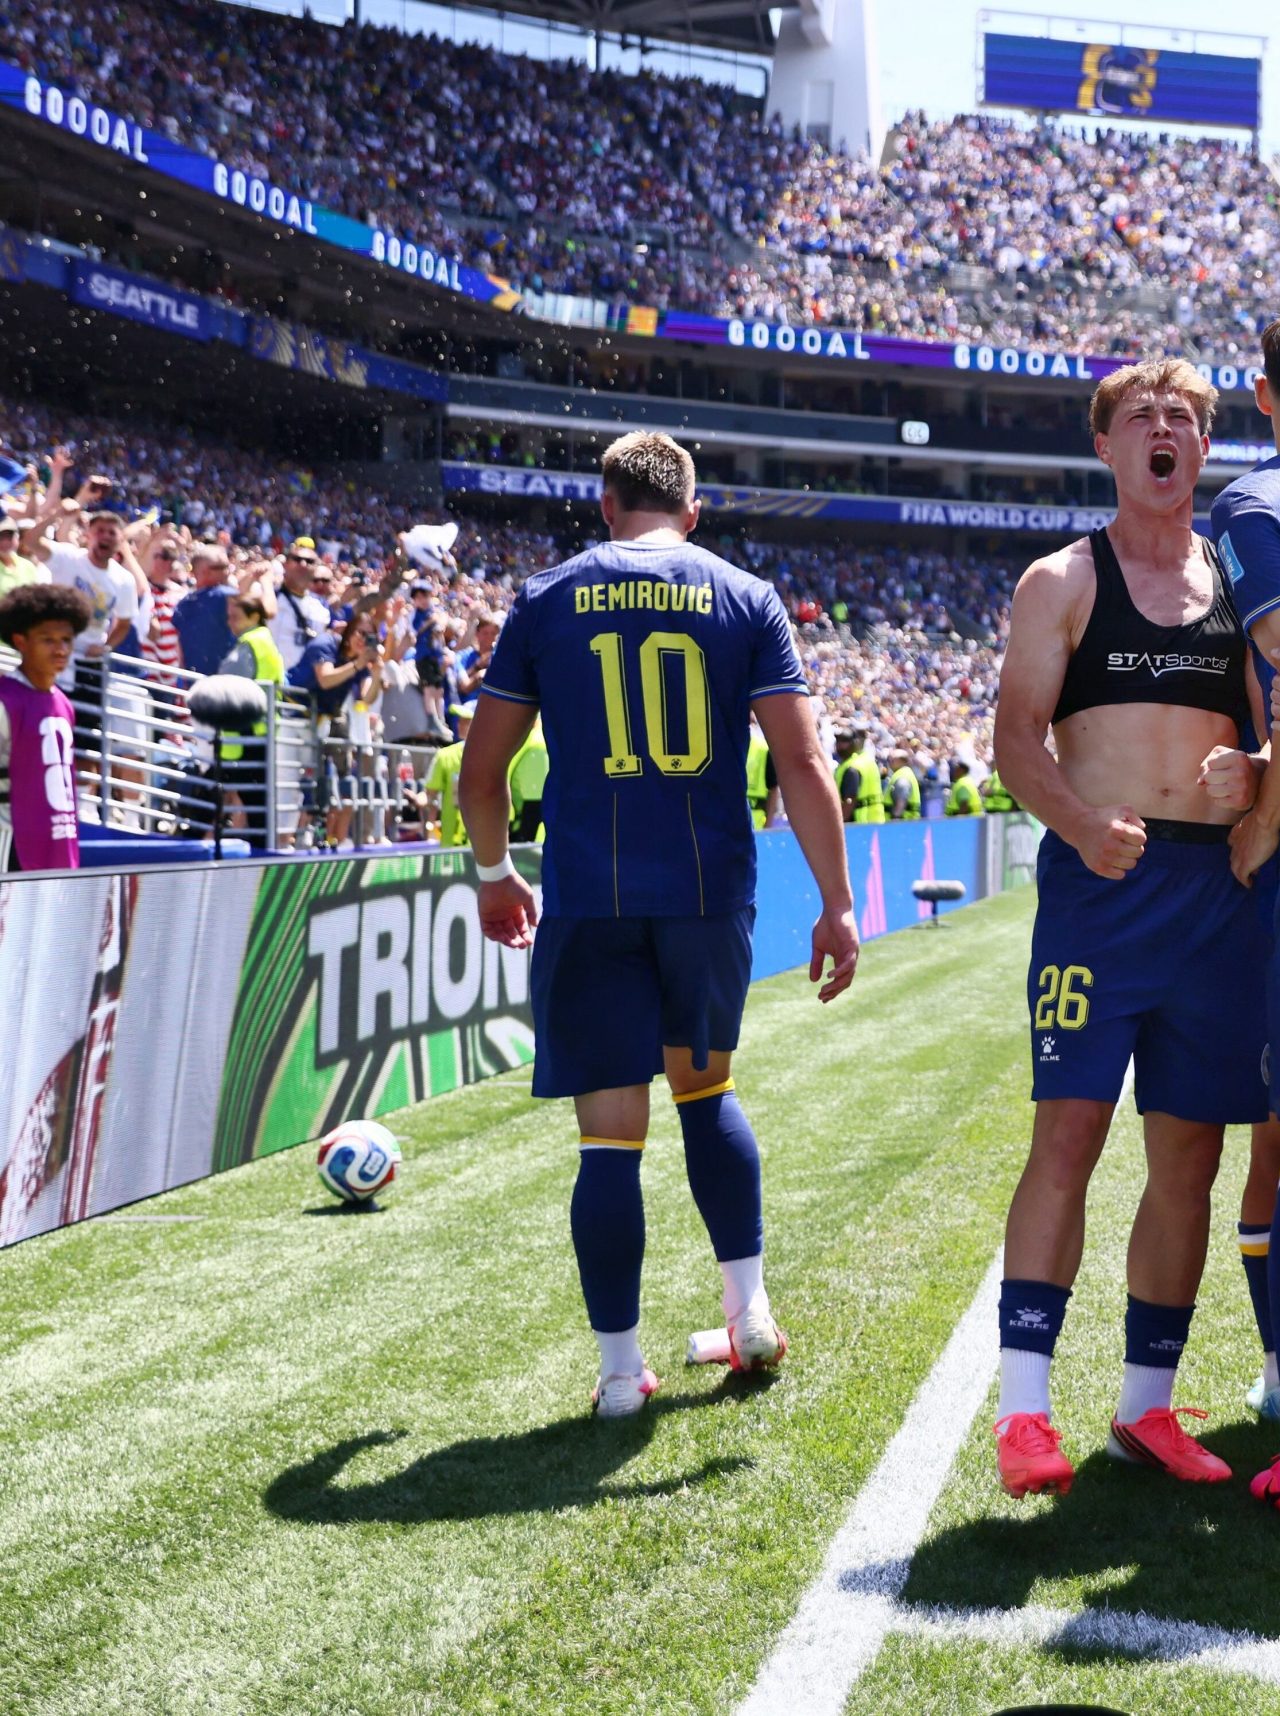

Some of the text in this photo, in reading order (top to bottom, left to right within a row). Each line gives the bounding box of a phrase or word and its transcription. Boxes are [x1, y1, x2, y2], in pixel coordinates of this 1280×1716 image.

[24, 77, 149, 163] GOOOAL
[212, 163, 318, 235] GOOOAL
[371, 231, 463, 292] GOOOAL
[89, 273, 200, 329] SEATTLE
[728, 319, 871, 360] GOOOAL
[953, 344, 1093, 380] GOOOAL
[480, 470, 603, 501] SEATT
[901, 503, 1112, 533] FIFA WORLD CUP 20
[575, 580, 713, 615] DEMIROVIĆ
[589, 631, 713, 778] 10
[307, 882, 544, 1055] TRION
[1036, 964, 1094, 1031] 26
[1009, 1319, 1049, 1331] KELME
